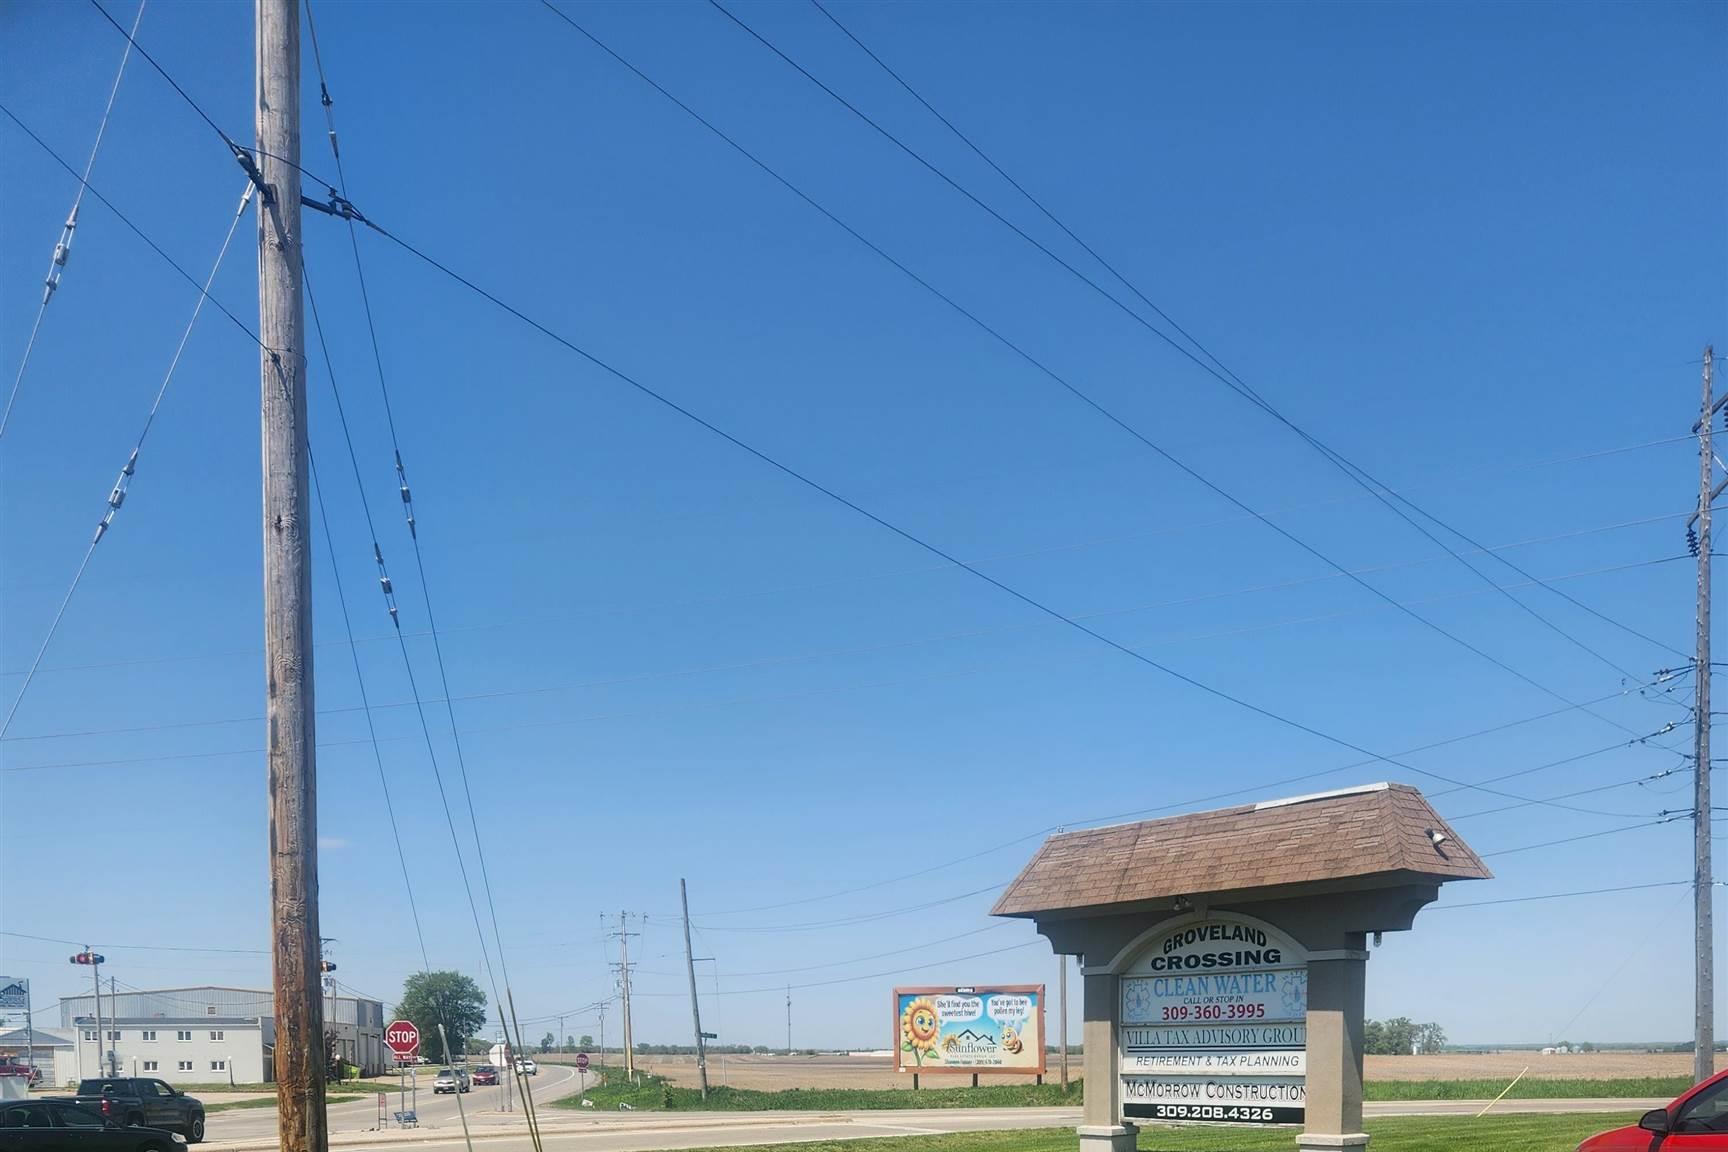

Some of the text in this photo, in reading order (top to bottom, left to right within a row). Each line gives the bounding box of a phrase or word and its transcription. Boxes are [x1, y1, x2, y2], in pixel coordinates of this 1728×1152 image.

[1163, 925, 1267, 955] GROVELAND
[1150, 949, 1281, 971] CROSSING
[1153, 973, 1277, 998] CLEAN WATER
[1183, 995, 1245, 1005] CALL OR STOP IN
[1162, 1003, 1265, 1021] 309-360-3995
[388, 1030, 417, 1043] STOP
[1127, 1031, 1161, 1045] VILLA
[1163, 1030, 1192, 1045] TAX
[1192, 1027, 1260, 1044] ADVISORY
[949, 1042, 997, 1053] Sunflower
[1136, 1056, 1300, 1067] RETIREMENT & TAX PLANNING
[1156, 1105, 1274, 1121] 309.208.4326
